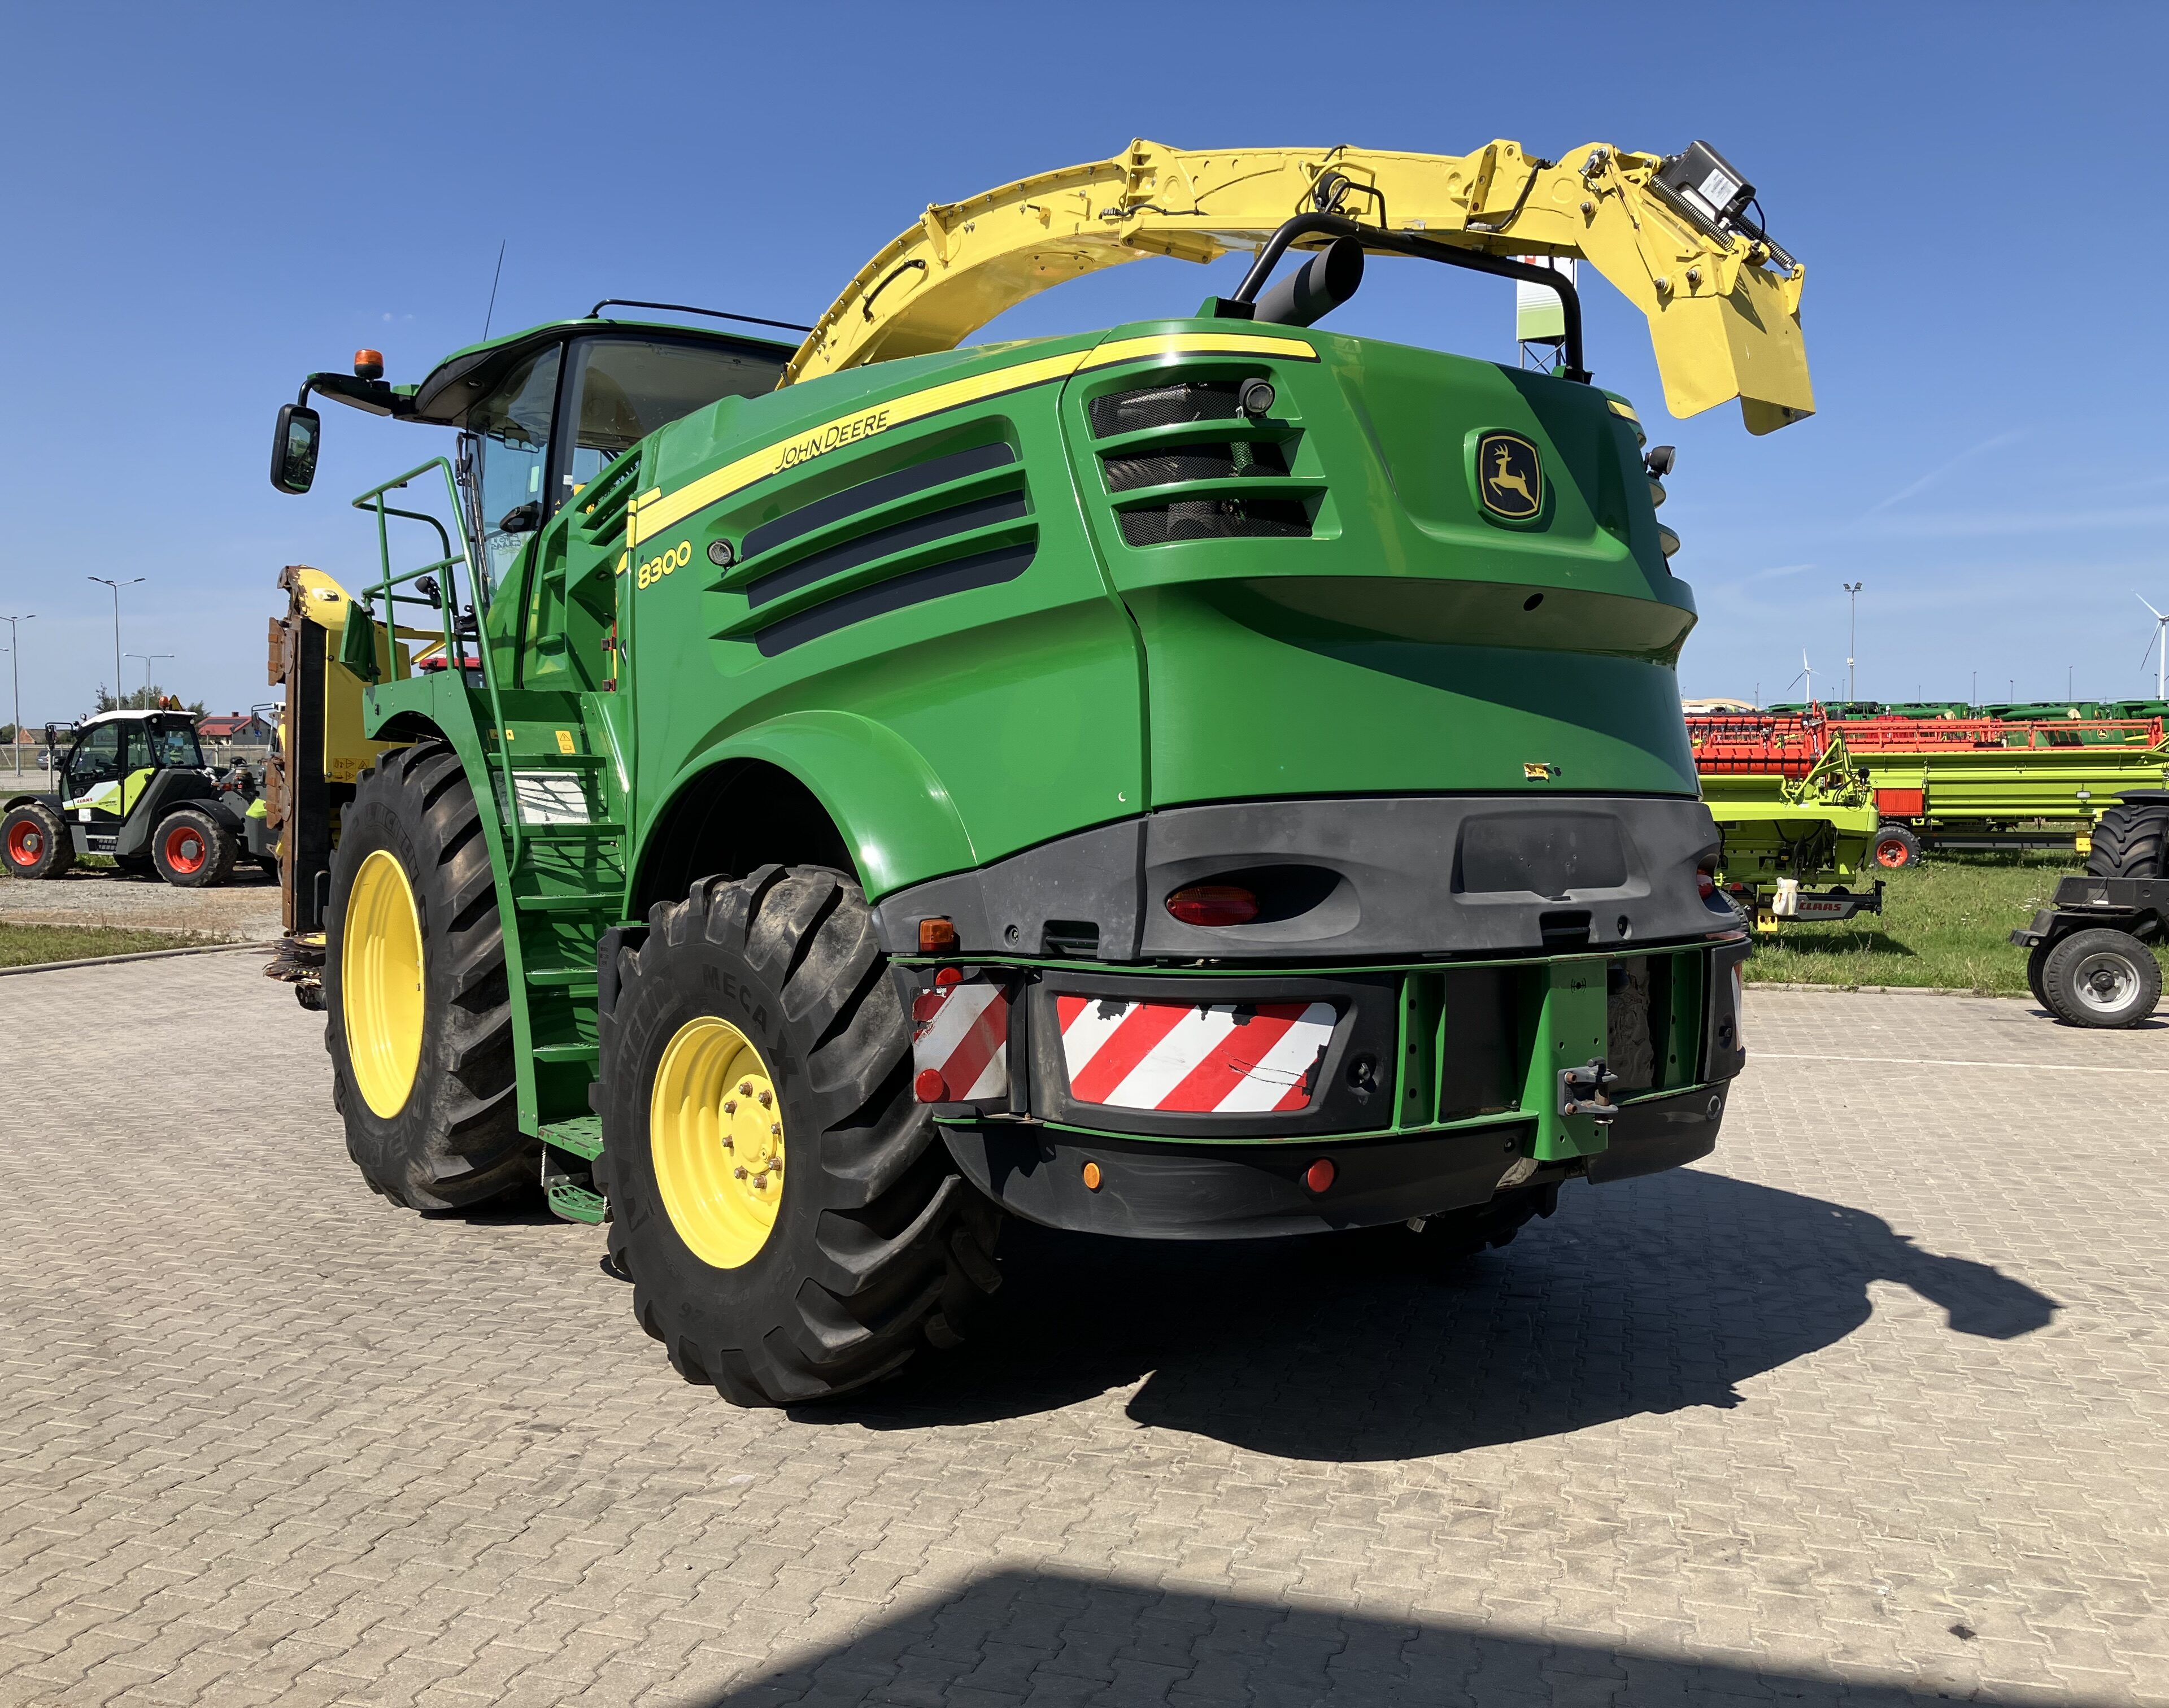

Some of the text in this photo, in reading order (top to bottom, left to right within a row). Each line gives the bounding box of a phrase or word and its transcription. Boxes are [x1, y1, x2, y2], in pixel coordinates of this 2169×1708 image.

[775, 409, 890, 470] JOHN DEERE
[638, 539, 692, 591] 8300
[1798, 902, 1843, 912] CLAAS
